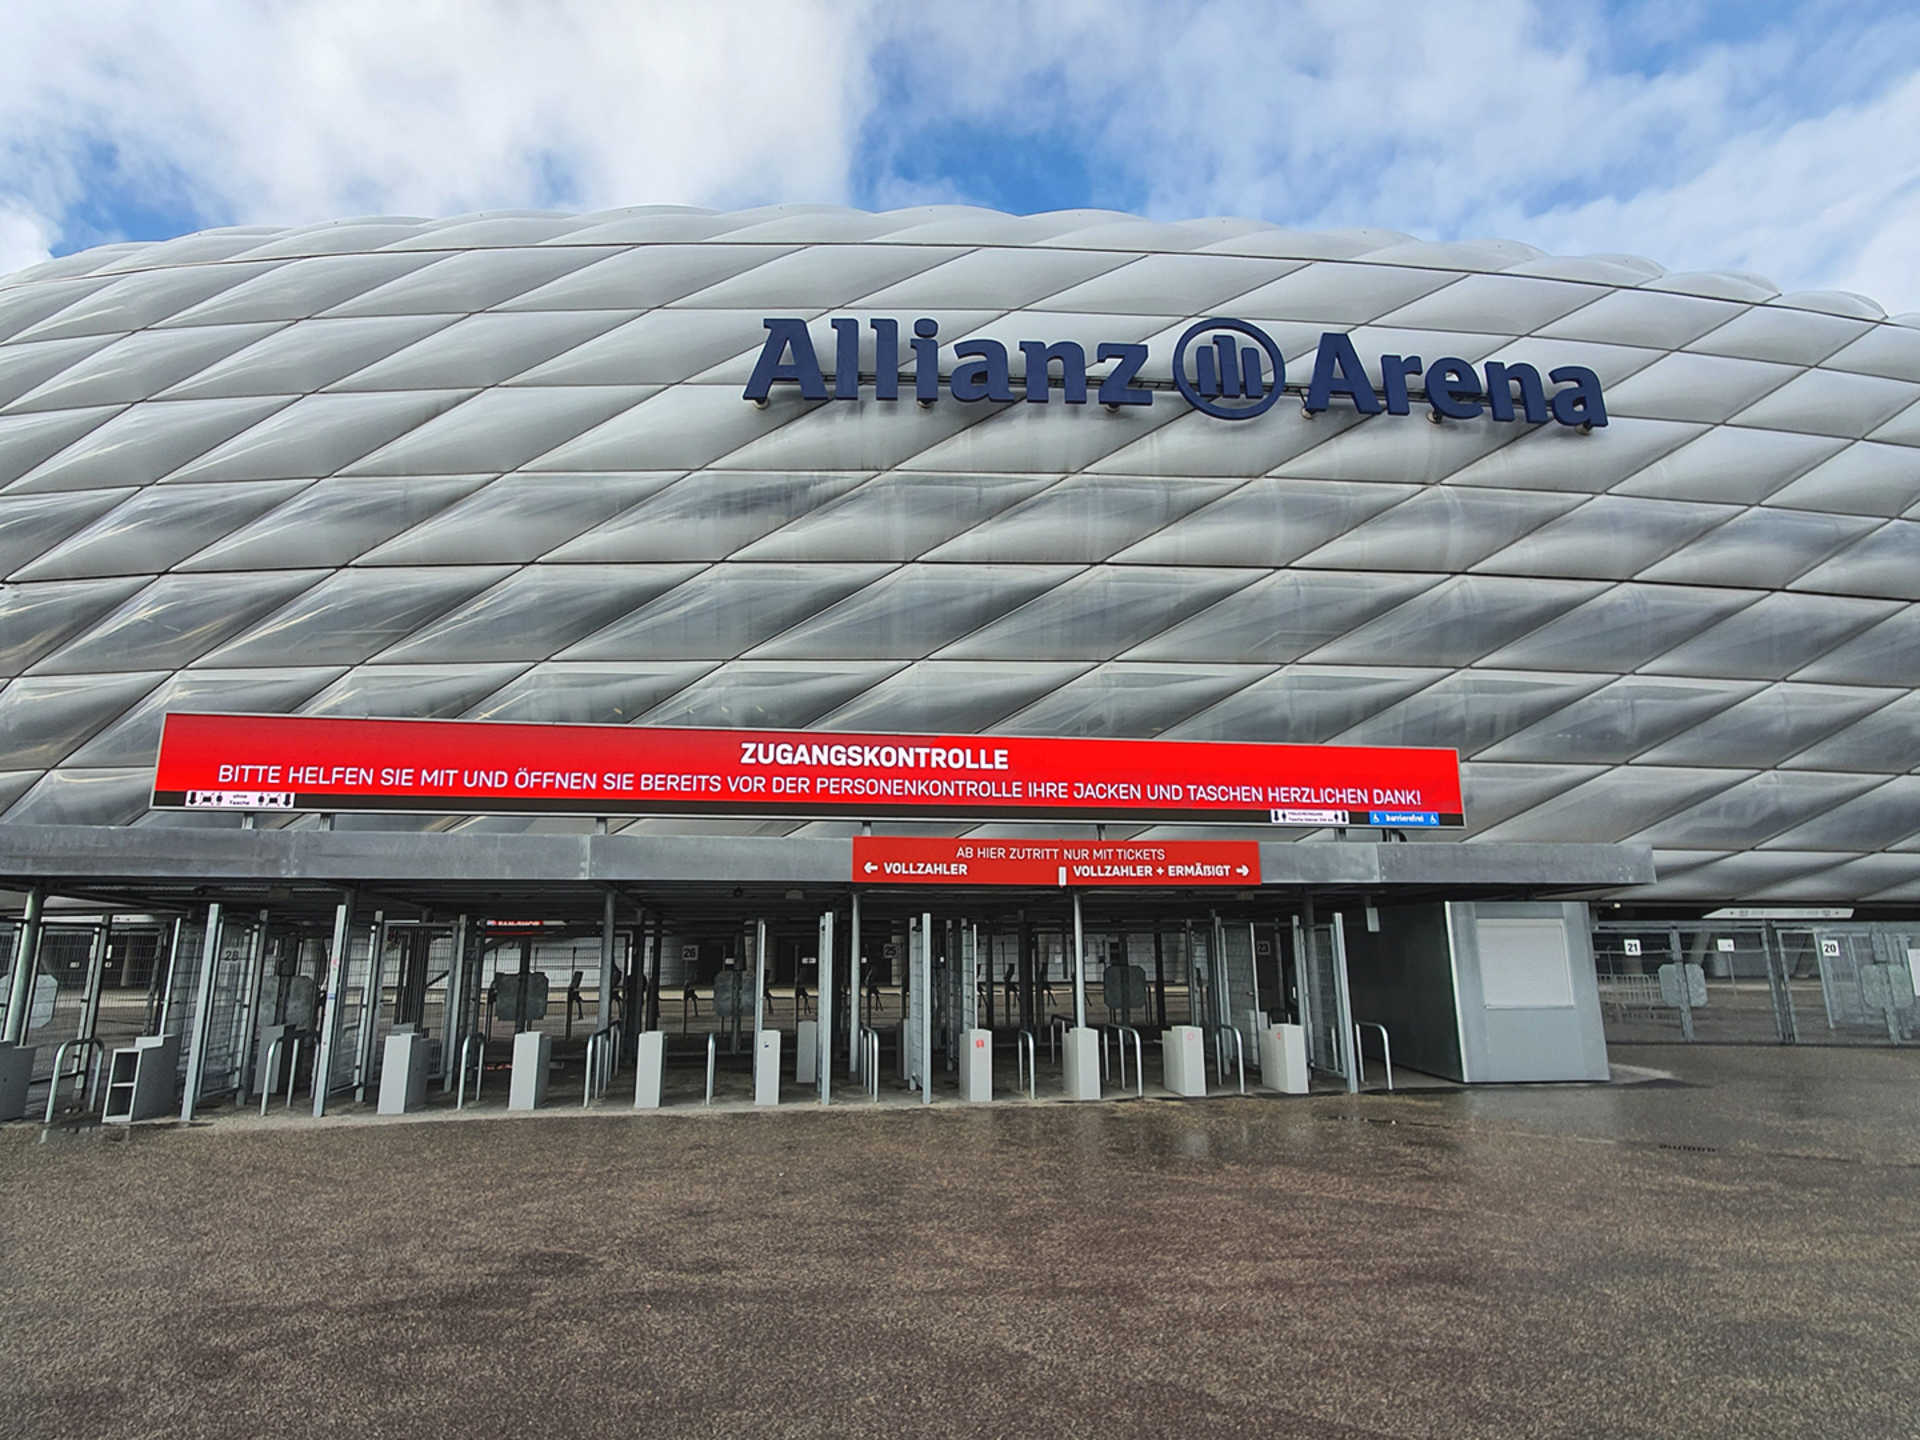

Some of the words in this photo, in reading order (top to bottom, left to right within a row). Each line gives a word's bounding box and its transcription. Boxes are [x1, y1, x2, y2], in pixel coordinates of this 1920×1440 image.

[743, 318, 1153, 406] Allianz
[1303, 332, 1608, 428] Arena
[740, 742, 1009, 770] ZUGANGSKONTROLLE
[218, 764, 282, 784] BITTE
[288, 766, 374, 785] HELFEN
[380, 767, 415, 786] SIE
[420, 768, 459, 787] MIT
[463, 770, 509, 788] UND
[514, 767, 597, 790] ÖFFNEN
[602, 772, 635, 791] SIE
[640, 773, 722, 792] BEREITS
[727, 775, 766, 793] VOR
[772, 776, 811, 794] DER
[816, 777, 1023, 799] PERSONENKONTROLLE
[1028, 781, 1069, 799] IHRE
[1073, 782, 1142, 800] JACKEN
[1146, 784, 1183, 801] UND
[1186, 784, 1264, 803] TASCHEN
[1267, 786, 1369, 805] HERZLICHEN
[1372, 788, 1422, 806] DANK!
[956, 846, 974, 859] AB
[977, 847, 1006, 860] HIER
[1009, 847, 1060, 860] ZUTRITT
[1063, 848, 1090, 861] NUR
[1092, 848, 1114, 861] MIT
[1115, 848, 1166, 861] TICKETS
[883, 862, 968, 876] VOLLZAHLER
[1072, 864, 1153, 877] VOLLZAHLER
[1627, 943, 1638, 952] 21
[1823, 943, 1837, 953] 20
